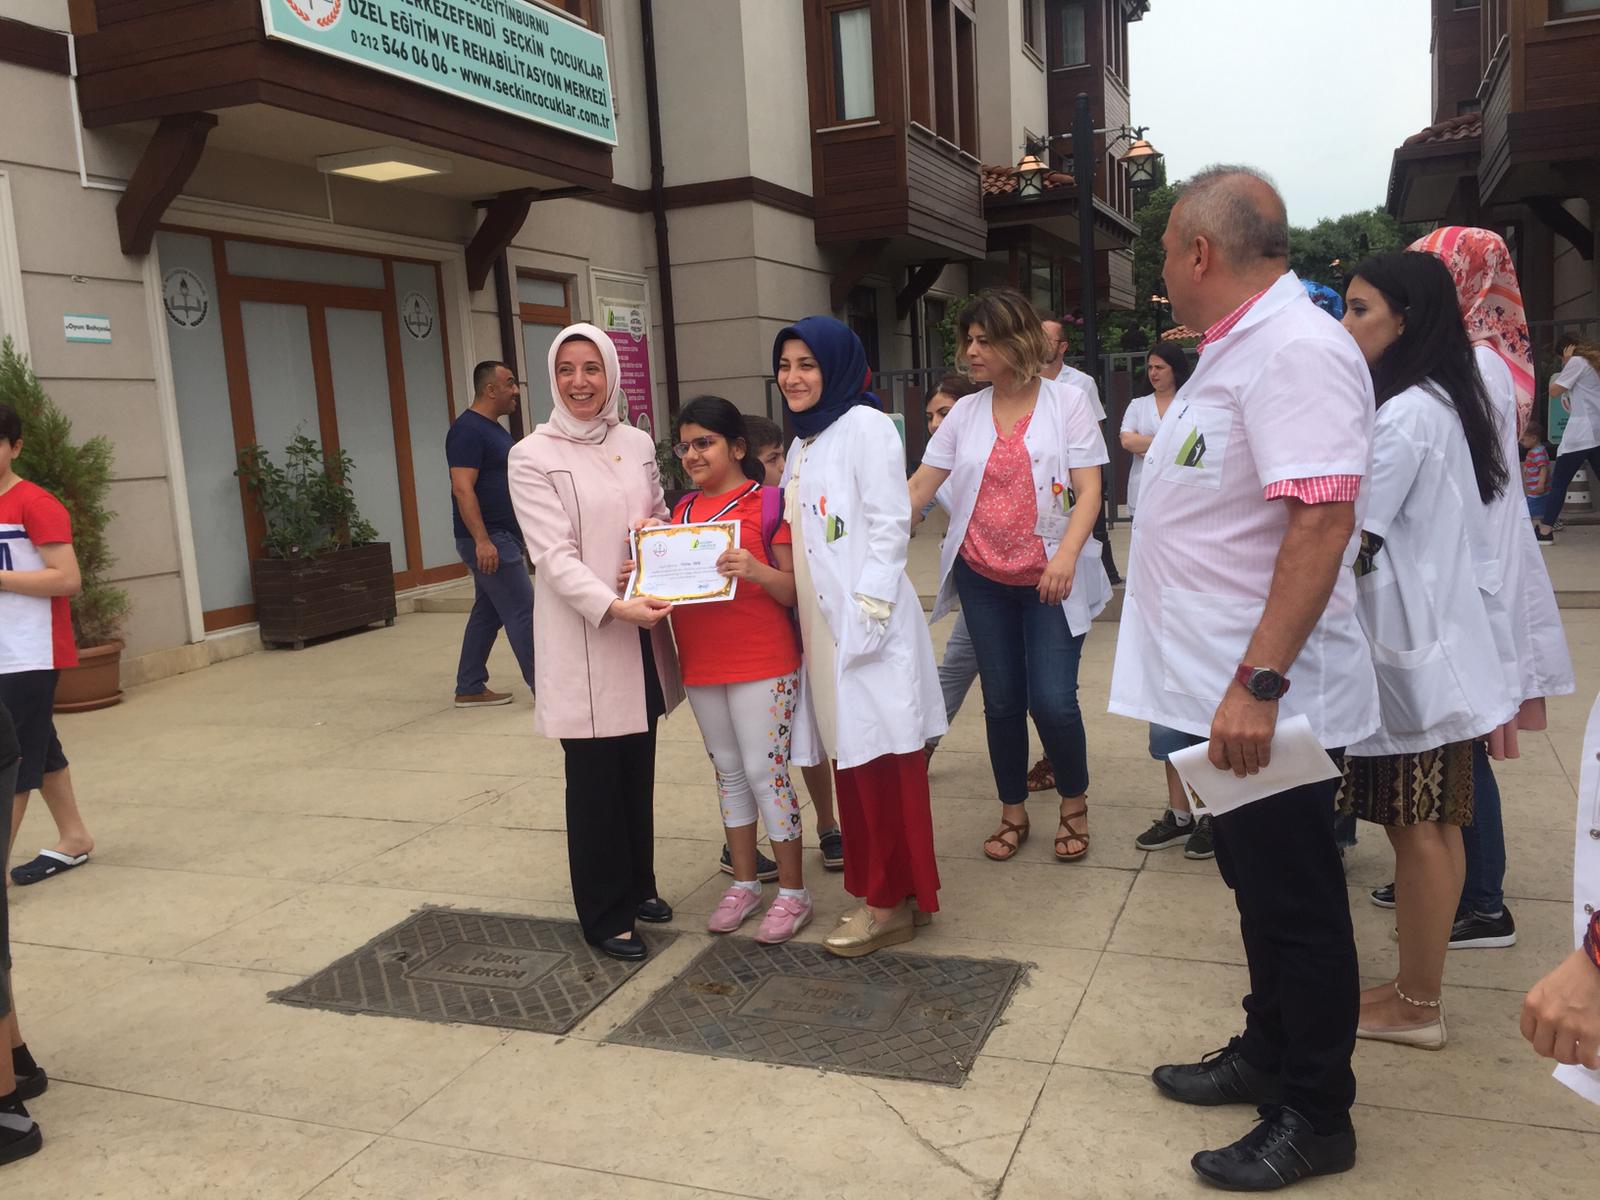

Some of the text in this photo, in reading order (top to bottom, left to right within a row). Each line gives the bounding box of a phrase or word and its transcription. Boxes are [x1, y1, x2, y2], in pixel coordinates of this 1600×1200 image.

[351, 29, 358, 43] 0
[360, 33, 379, 51] 212
[381, 34, 408, 61] 546
[411, 45, 429, 68] 06
[431, 53, 448, 75] 06
[459, 66, 610, 129] www.seckincocuklar.com.tr
[390, 10, 440, 46] EĞİTİM
[442, 30, 460, 54] VE
[462, 39, 562, 91] REHABİLİTASYON
[563, 77, 607, 107] MERKEZİ
[503, 27, 545, 58] SEÇKİN
[550, 46, 604, 81] ÇOCUKLAR
[437, 963, 528, 980] TELEKOM
